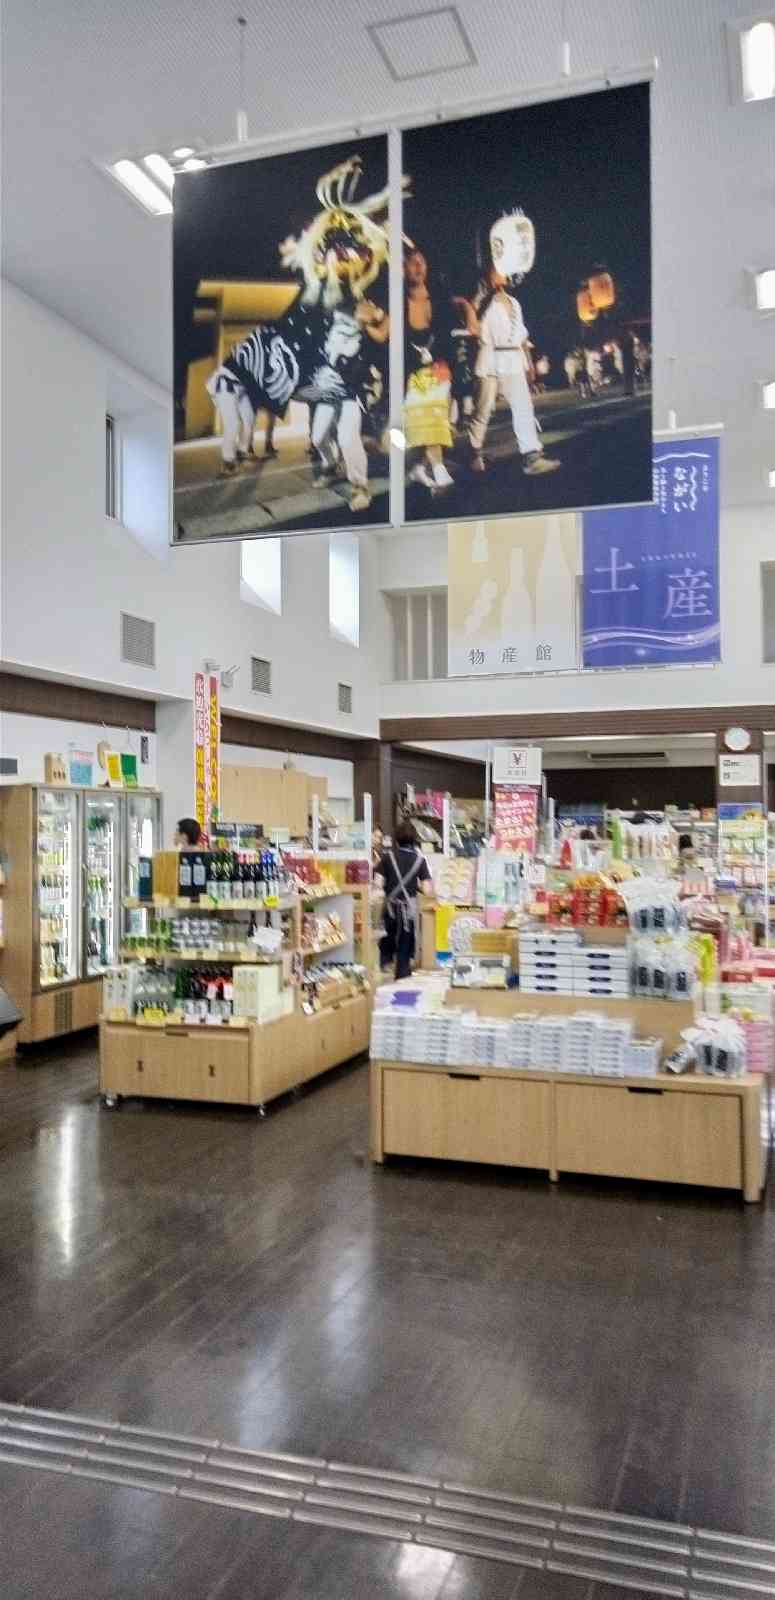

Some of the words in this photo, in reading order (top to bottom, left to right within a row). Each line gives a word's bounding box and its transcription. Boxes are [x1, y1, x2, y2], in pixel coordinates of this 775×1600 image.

[590, 547, 713, 619] 土産
[469, 644, 553, 665] 物産館
